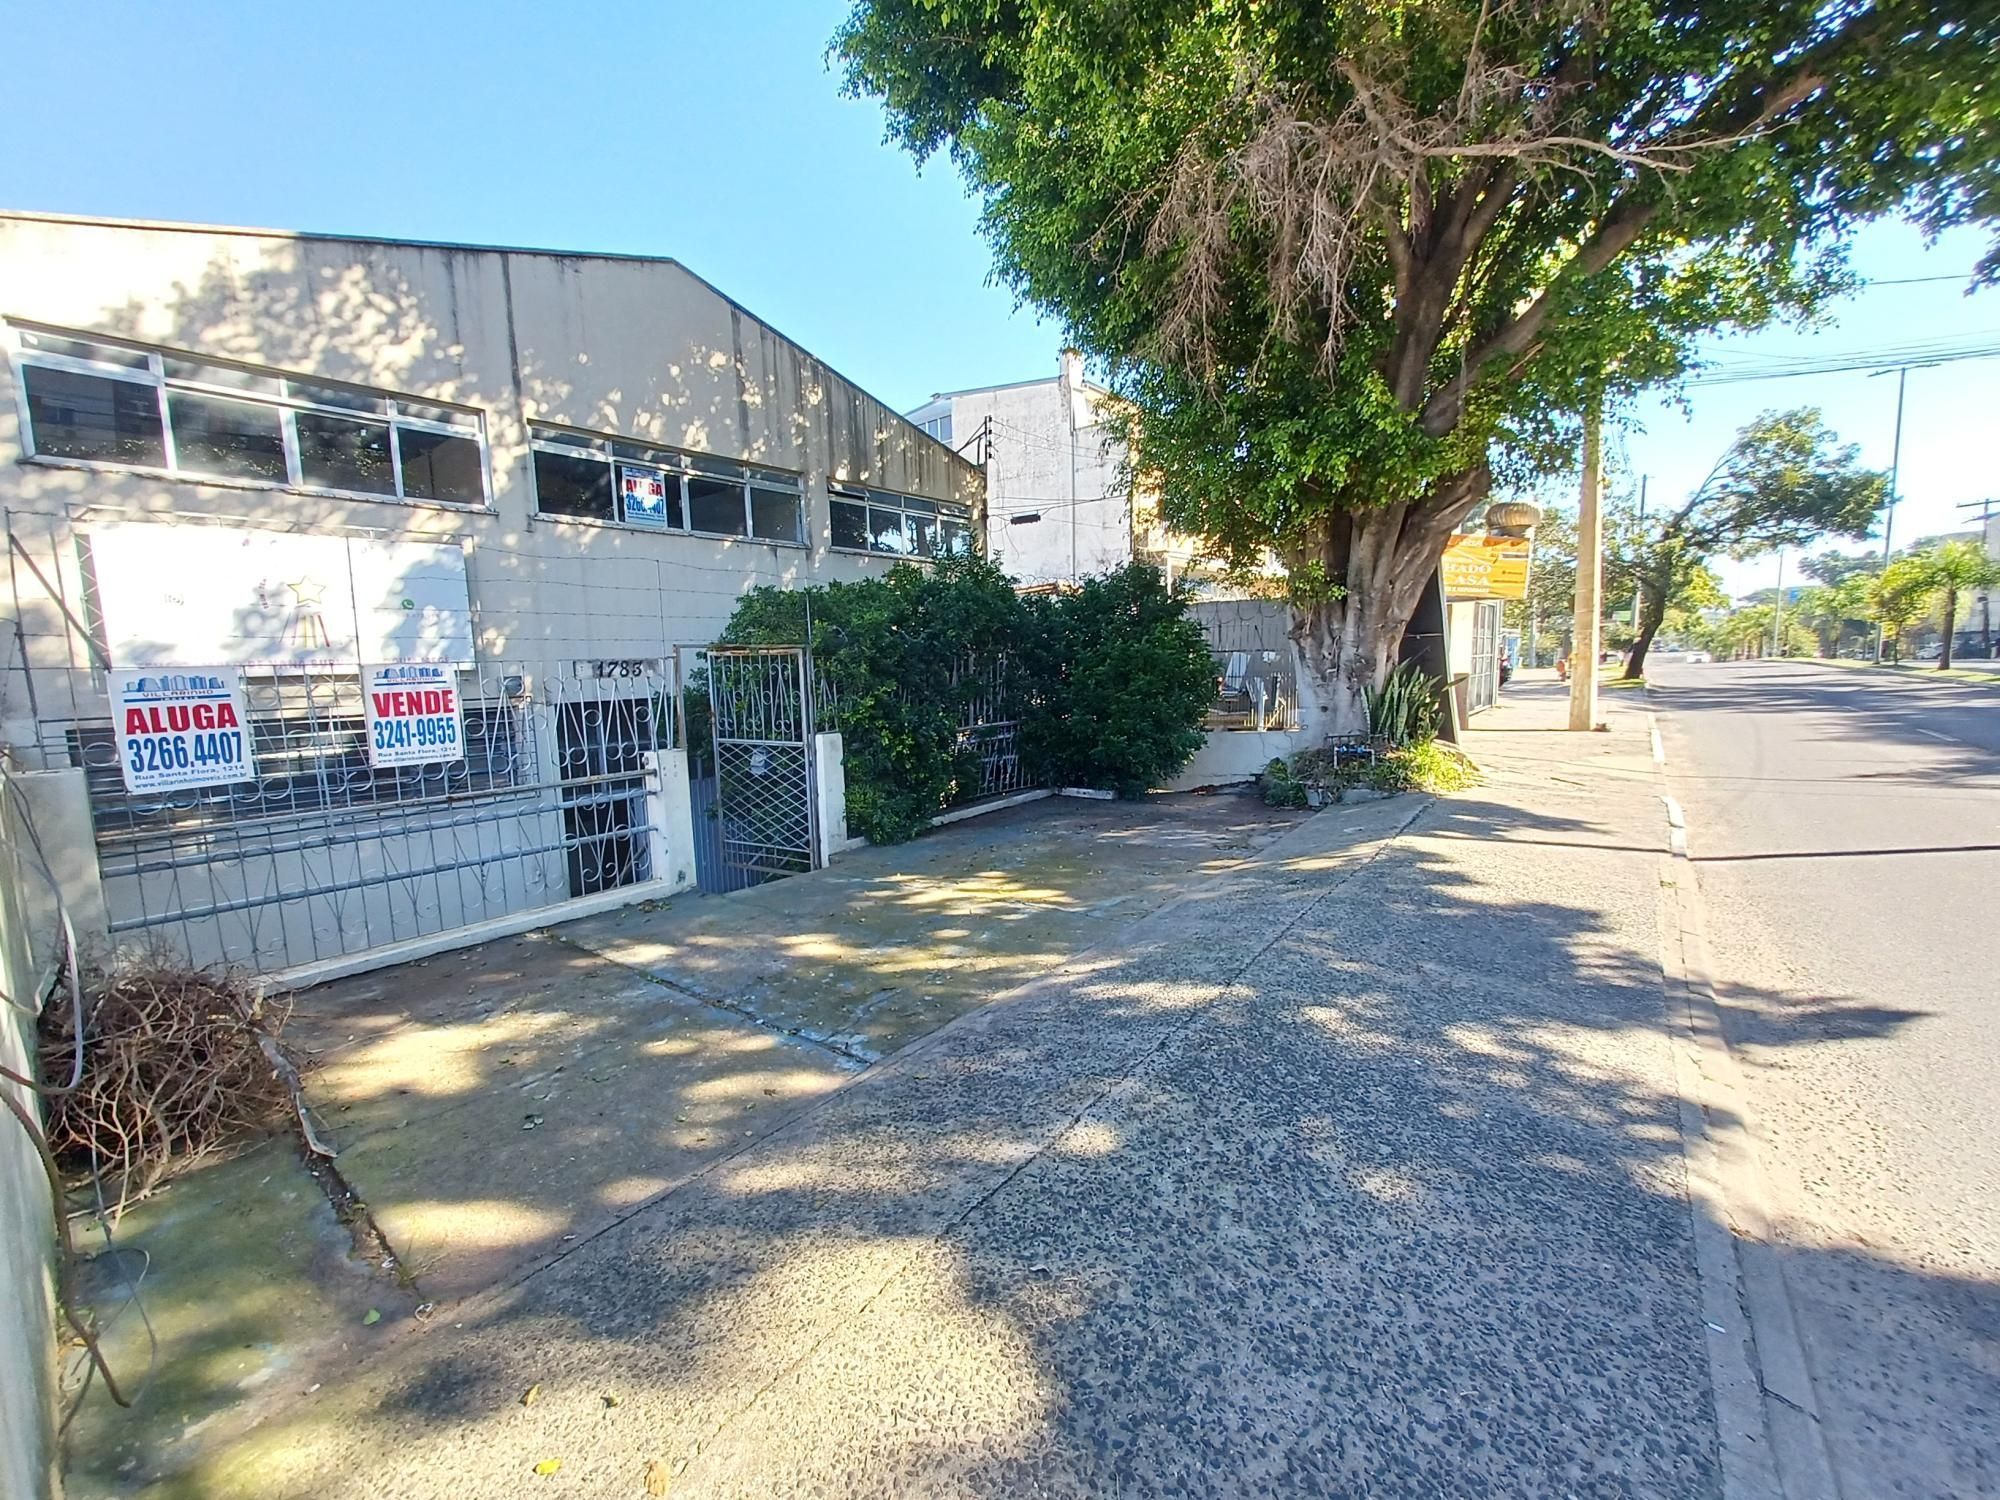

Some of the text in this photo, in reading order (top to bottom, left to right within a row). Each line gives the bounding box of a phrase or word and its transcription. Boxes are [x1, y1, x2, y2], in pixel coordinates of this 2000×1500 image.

[598, 660, 643, 678] 1783
[126, 703, 239, 735] ALUGA
[372, 690, 455, 718] VENDE
[374, 717, 456, 750] 3241-9955
[128, 731, 242, 773] 3266.4407
[158, 771, 188, 779] Santa
[222, 765, 245, 773] 1214
